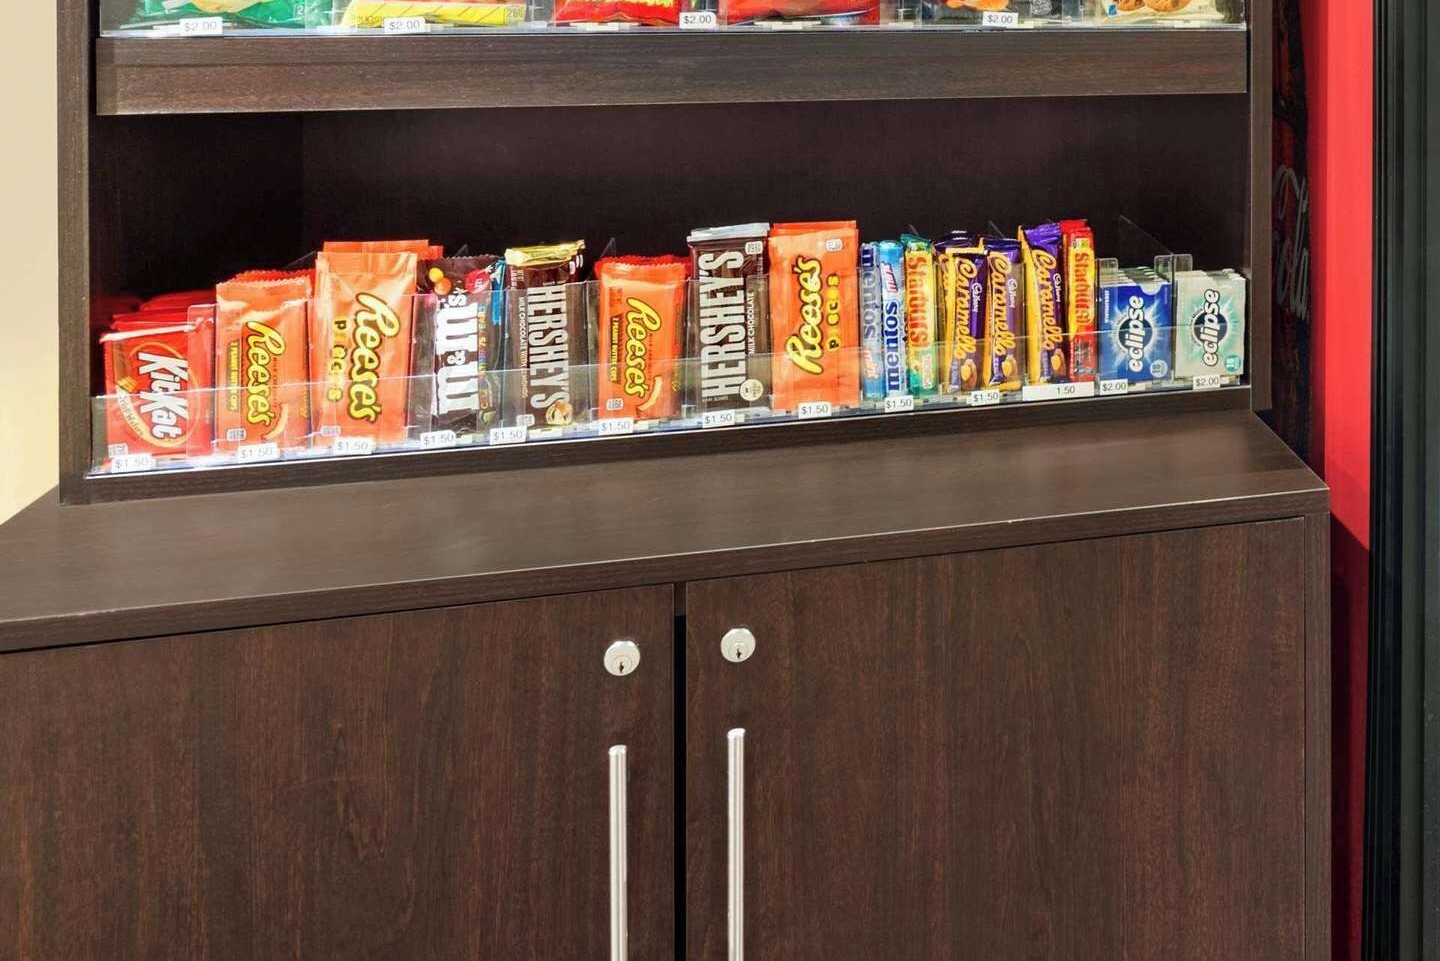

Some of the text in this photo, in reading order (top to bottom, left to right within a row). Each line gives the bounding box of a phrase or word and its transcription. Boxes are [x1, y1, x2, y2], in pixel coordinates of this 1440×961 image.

[184, 20, 217, 31] $2.00
[684, 15, 712, 25] $2.00
[987, 13, 1013, 24] $2.00
[518, 297, 526, 311] MILK
[862, 247, 879, 340] mentos
[519, 312, 528, 350] CHOCOLATE
[699, 250, 747, 398] HERSHEY'S
[747, 292, 755, 354] MILK CHOCOLATE
[786, 255, 824, 375] Reese's
[1125, 295, 1146, 373] eclipse
[1200, 288, 1222, 367] eclipse
[348, 292, 400, 424] Reese's
[527, 287, 570, 408] HERSHEY'S
[624, 297, 662, 398] Reese's
[883, 301, 900, 392] mentos
[246, 320, 286, 426] Reese's
[1057, 386, 1075, 394] 1.50
[1102, 383, 1127, 392] $2.00
[1195, 377, 1220, 387] $2.00
[801, 405, 829, 415] $1.50
[886, 399, 912, 409] $1.50
[973, 392, 999, 402] $1.50
[704, 414, 732, 424] $1.50
